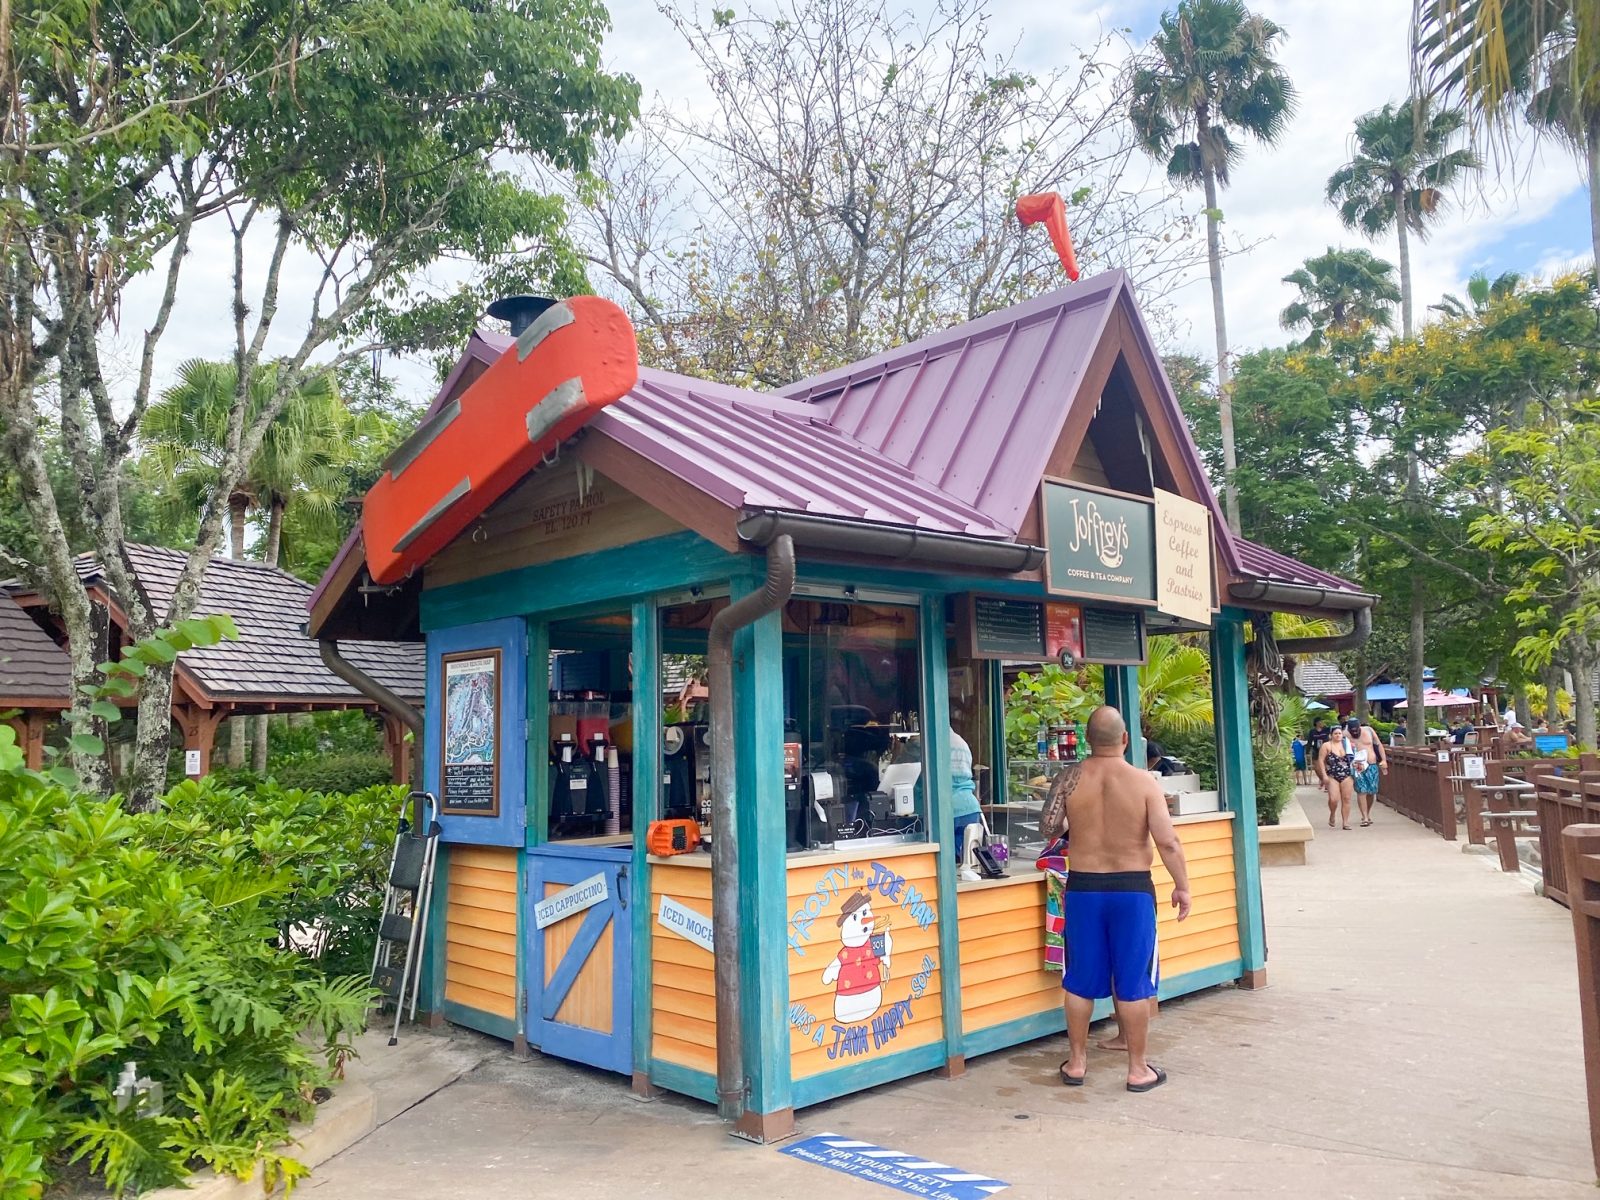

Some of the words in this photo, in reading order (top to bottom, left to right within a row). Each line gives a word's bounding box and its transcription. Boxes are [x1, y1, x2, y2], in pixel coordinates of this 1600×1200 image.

[533, 502, 567, 521] SAFETY
[570, 490, 605, 511] PATROL
[1069, 499, 1129, 557] Joffrey's
[1163, 510, 1202, 536] Espresso
[1169, 536, 1199, 560] Coffee
[1067, 568, 1091, 579] COFFEE
[1090, 571, 1096, 579] &
[1095, 572, 1107, 581] TEA
[1107, 574, 1134, 585] COMPANY
[1176, 564, 1193, 579] and
[1166, 577, 1203, 601] Pastries
[538, 905, 555, 921] ICED
[555, 881, 603, 914] CAPPUCCINO
[788, 864, 849, 956] FROSTY
[851, 867, 865, 881] the
[662, 905, 684, 926] ICED
[685, 918, 713, 943] MOCH
[872, 939, 884, 950] JOE
[789, 1001, 816, 1036] WAS
[812, 1023, 825, 1047] A
[827, 1024, 869, 1060] JAVA
[871, 995, 914, 1050] HAPPY
[911, 954, 936, 999] SOUL
[790, 1147, 827, 1161] Please
[827, 1159, 862, 1171] WAIT
[859, 1168, 902, 1185] Behind
[902, 1181, 929, 1194] This
[823, 1149, 853, 1160] FOR
[852, 1155, 893, 1171] YOUR
[892, 1169, 953, 1188] SAFETY
